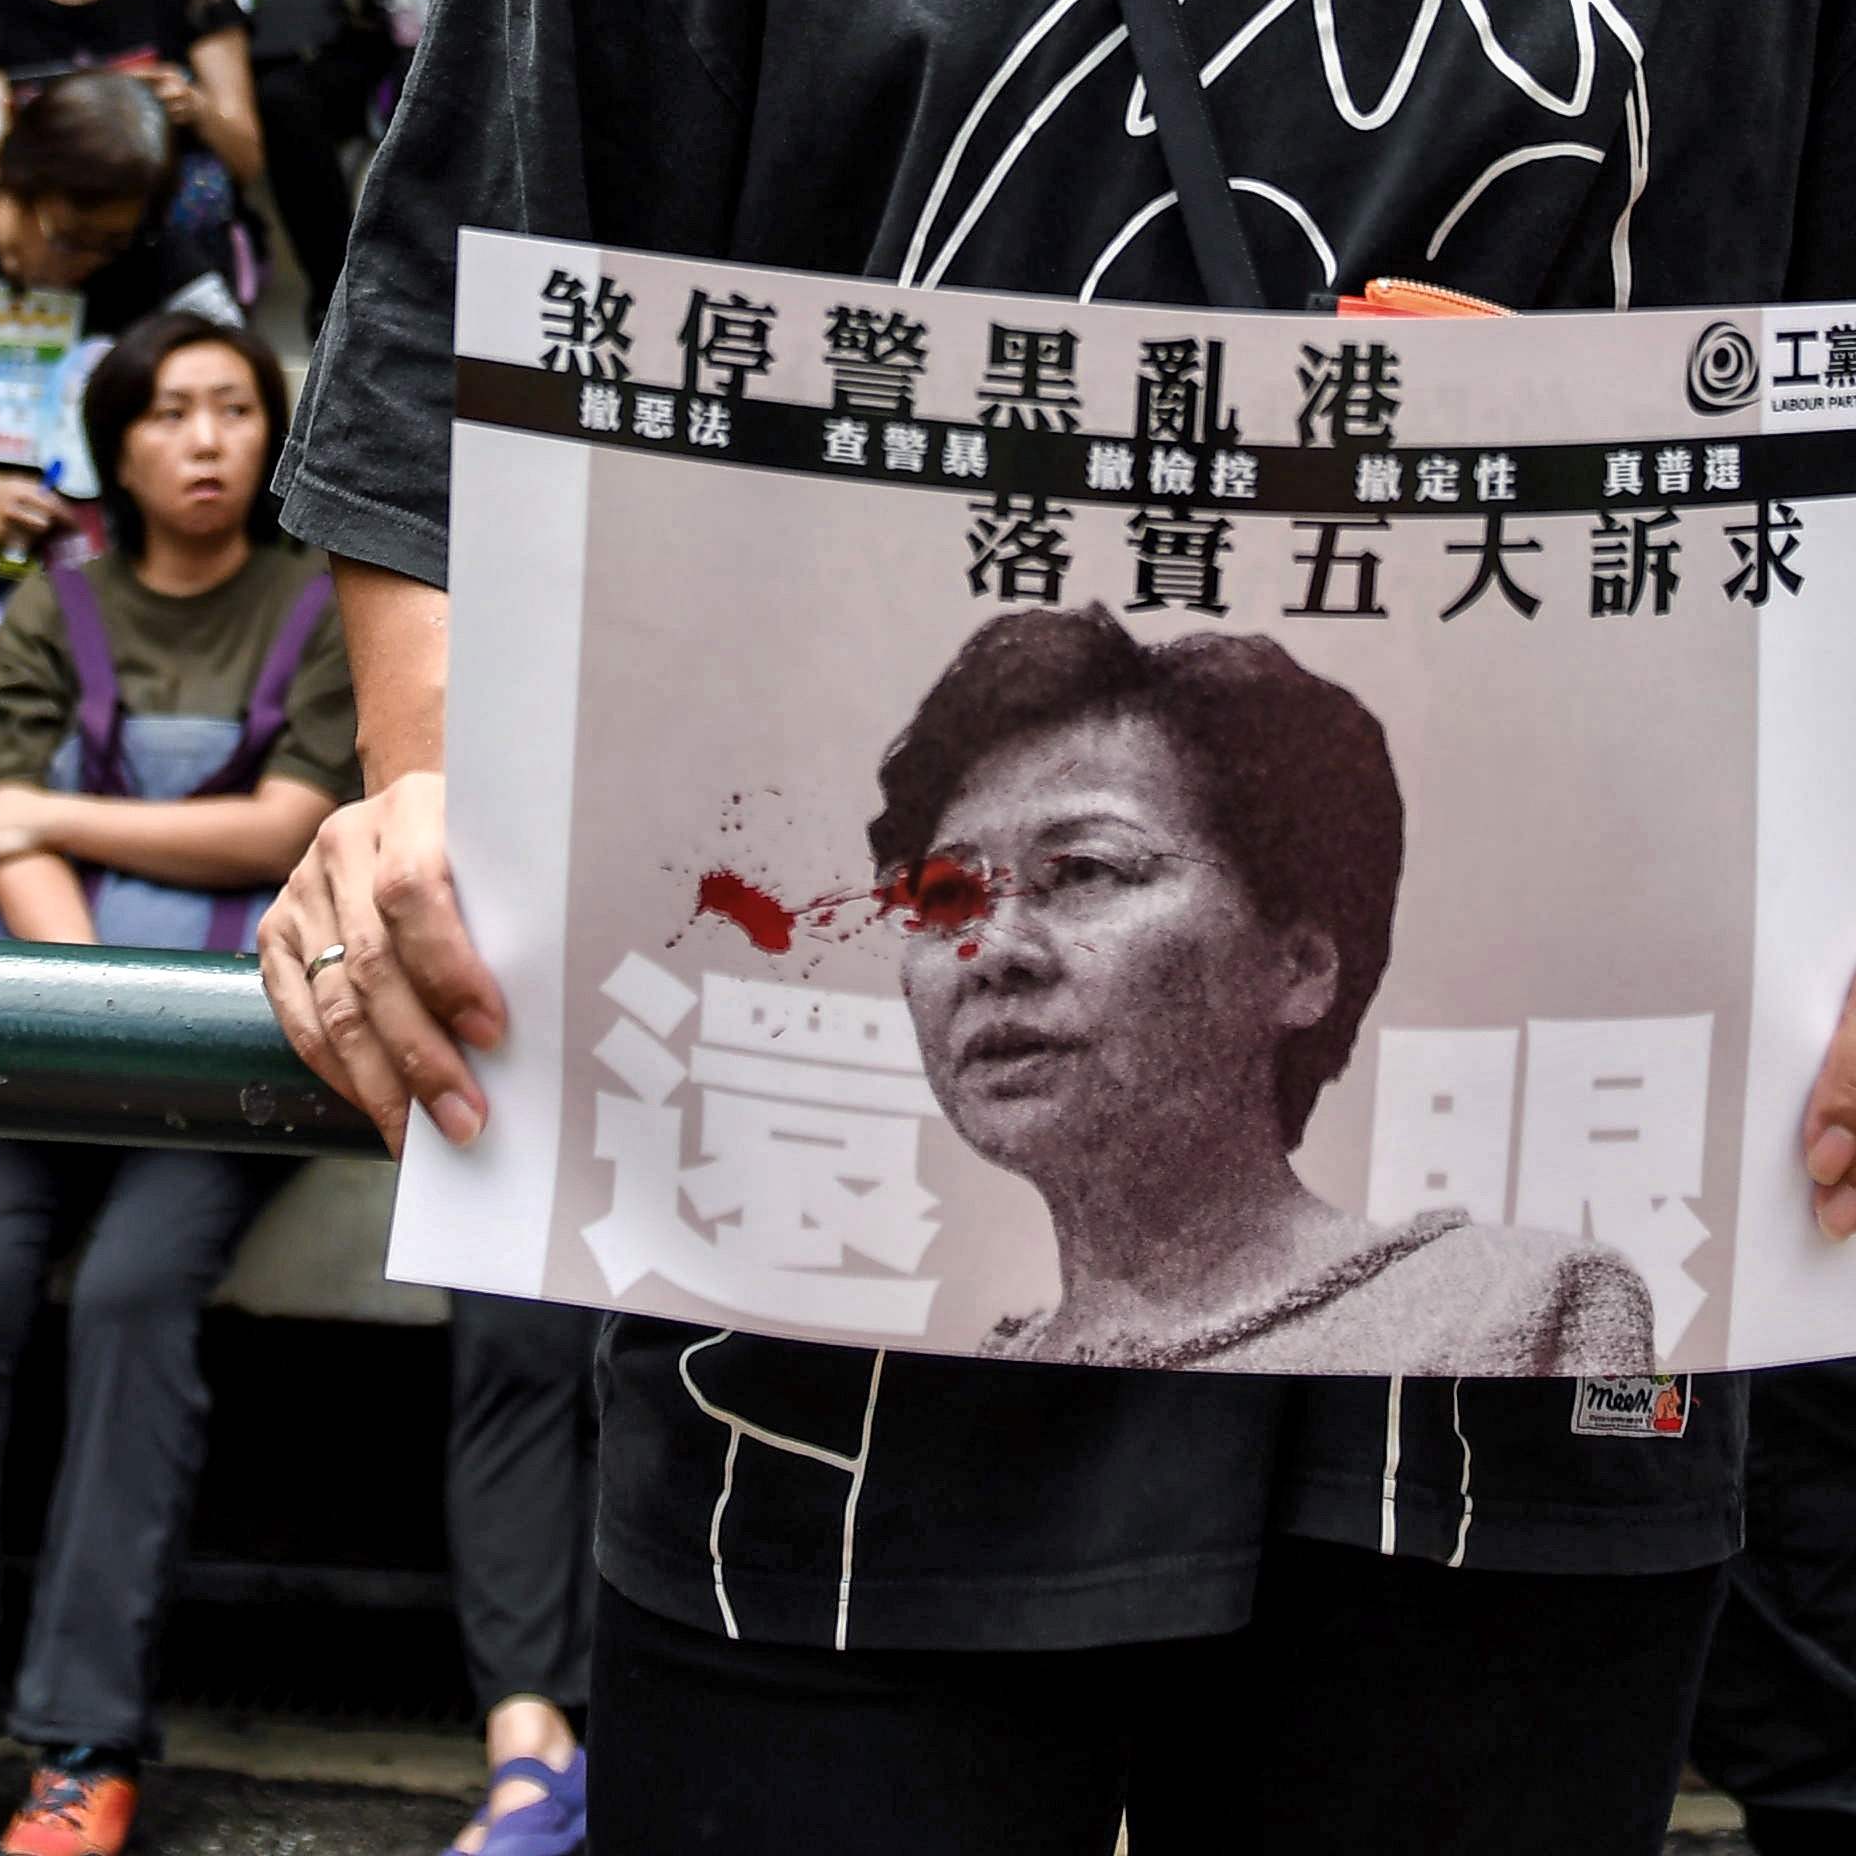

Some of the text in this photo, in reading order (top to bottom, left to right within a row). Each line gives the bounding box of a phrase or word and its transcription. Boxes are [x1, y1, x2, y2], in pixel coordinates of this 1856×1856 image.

[541, 269, 1401, 447] 煞停警黑亂港
[1772, 397, 1825, 412] LABOUR
[823, 419, 987, 478] 查警暴
[1353, 453, 1518, 503] 撤定性
[1602, 445, 1743, 498] 真普選
[966, 494, 1805, 622] 落實五大訴求
